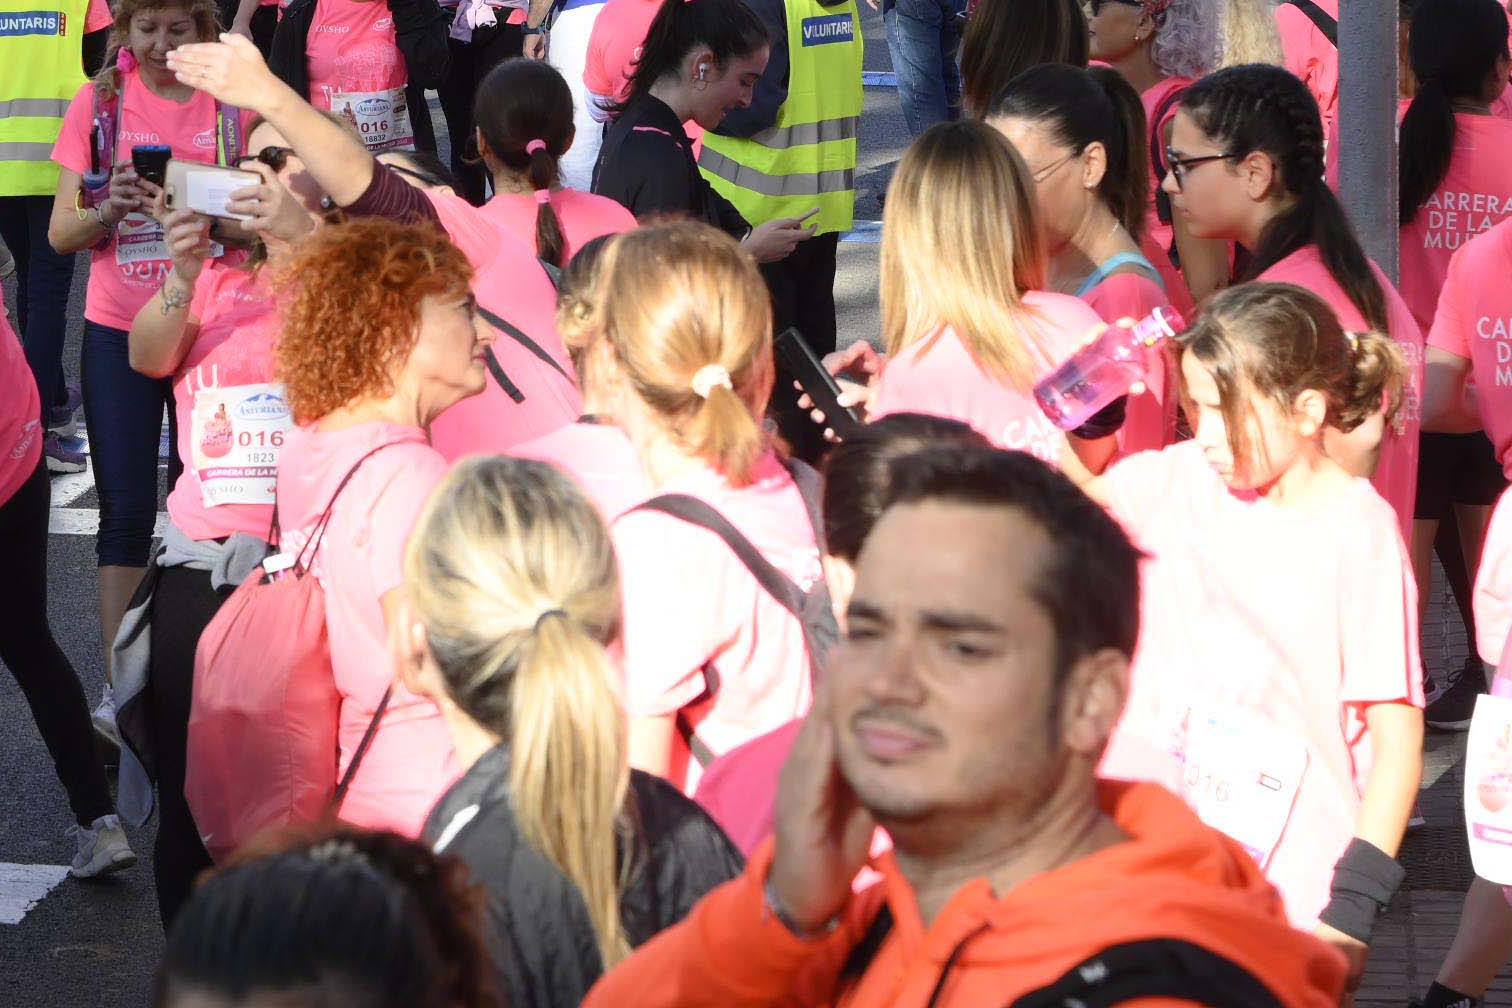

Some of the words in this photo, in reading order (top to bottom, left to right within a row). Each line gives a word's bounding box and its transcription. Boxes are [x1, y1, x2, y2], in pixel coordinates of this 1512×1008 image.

[315, 24, 350, 32] OYSHO
[361, 120, 388, 132] 016
[119, 131, 159, 143] OYSHO
[365, 134, 386, 142] 18832
[1429, 211, 1457, 230] DE
[1467, 215, 1493, 233] LA
[125, 247, 158, 256] OYSHO
[239, 431, 284, 447] 016
[207, 469, 242, 478] CARRERA
[244, 468, 255, 476] DE
[1188, 764, 1229, 803] 016
